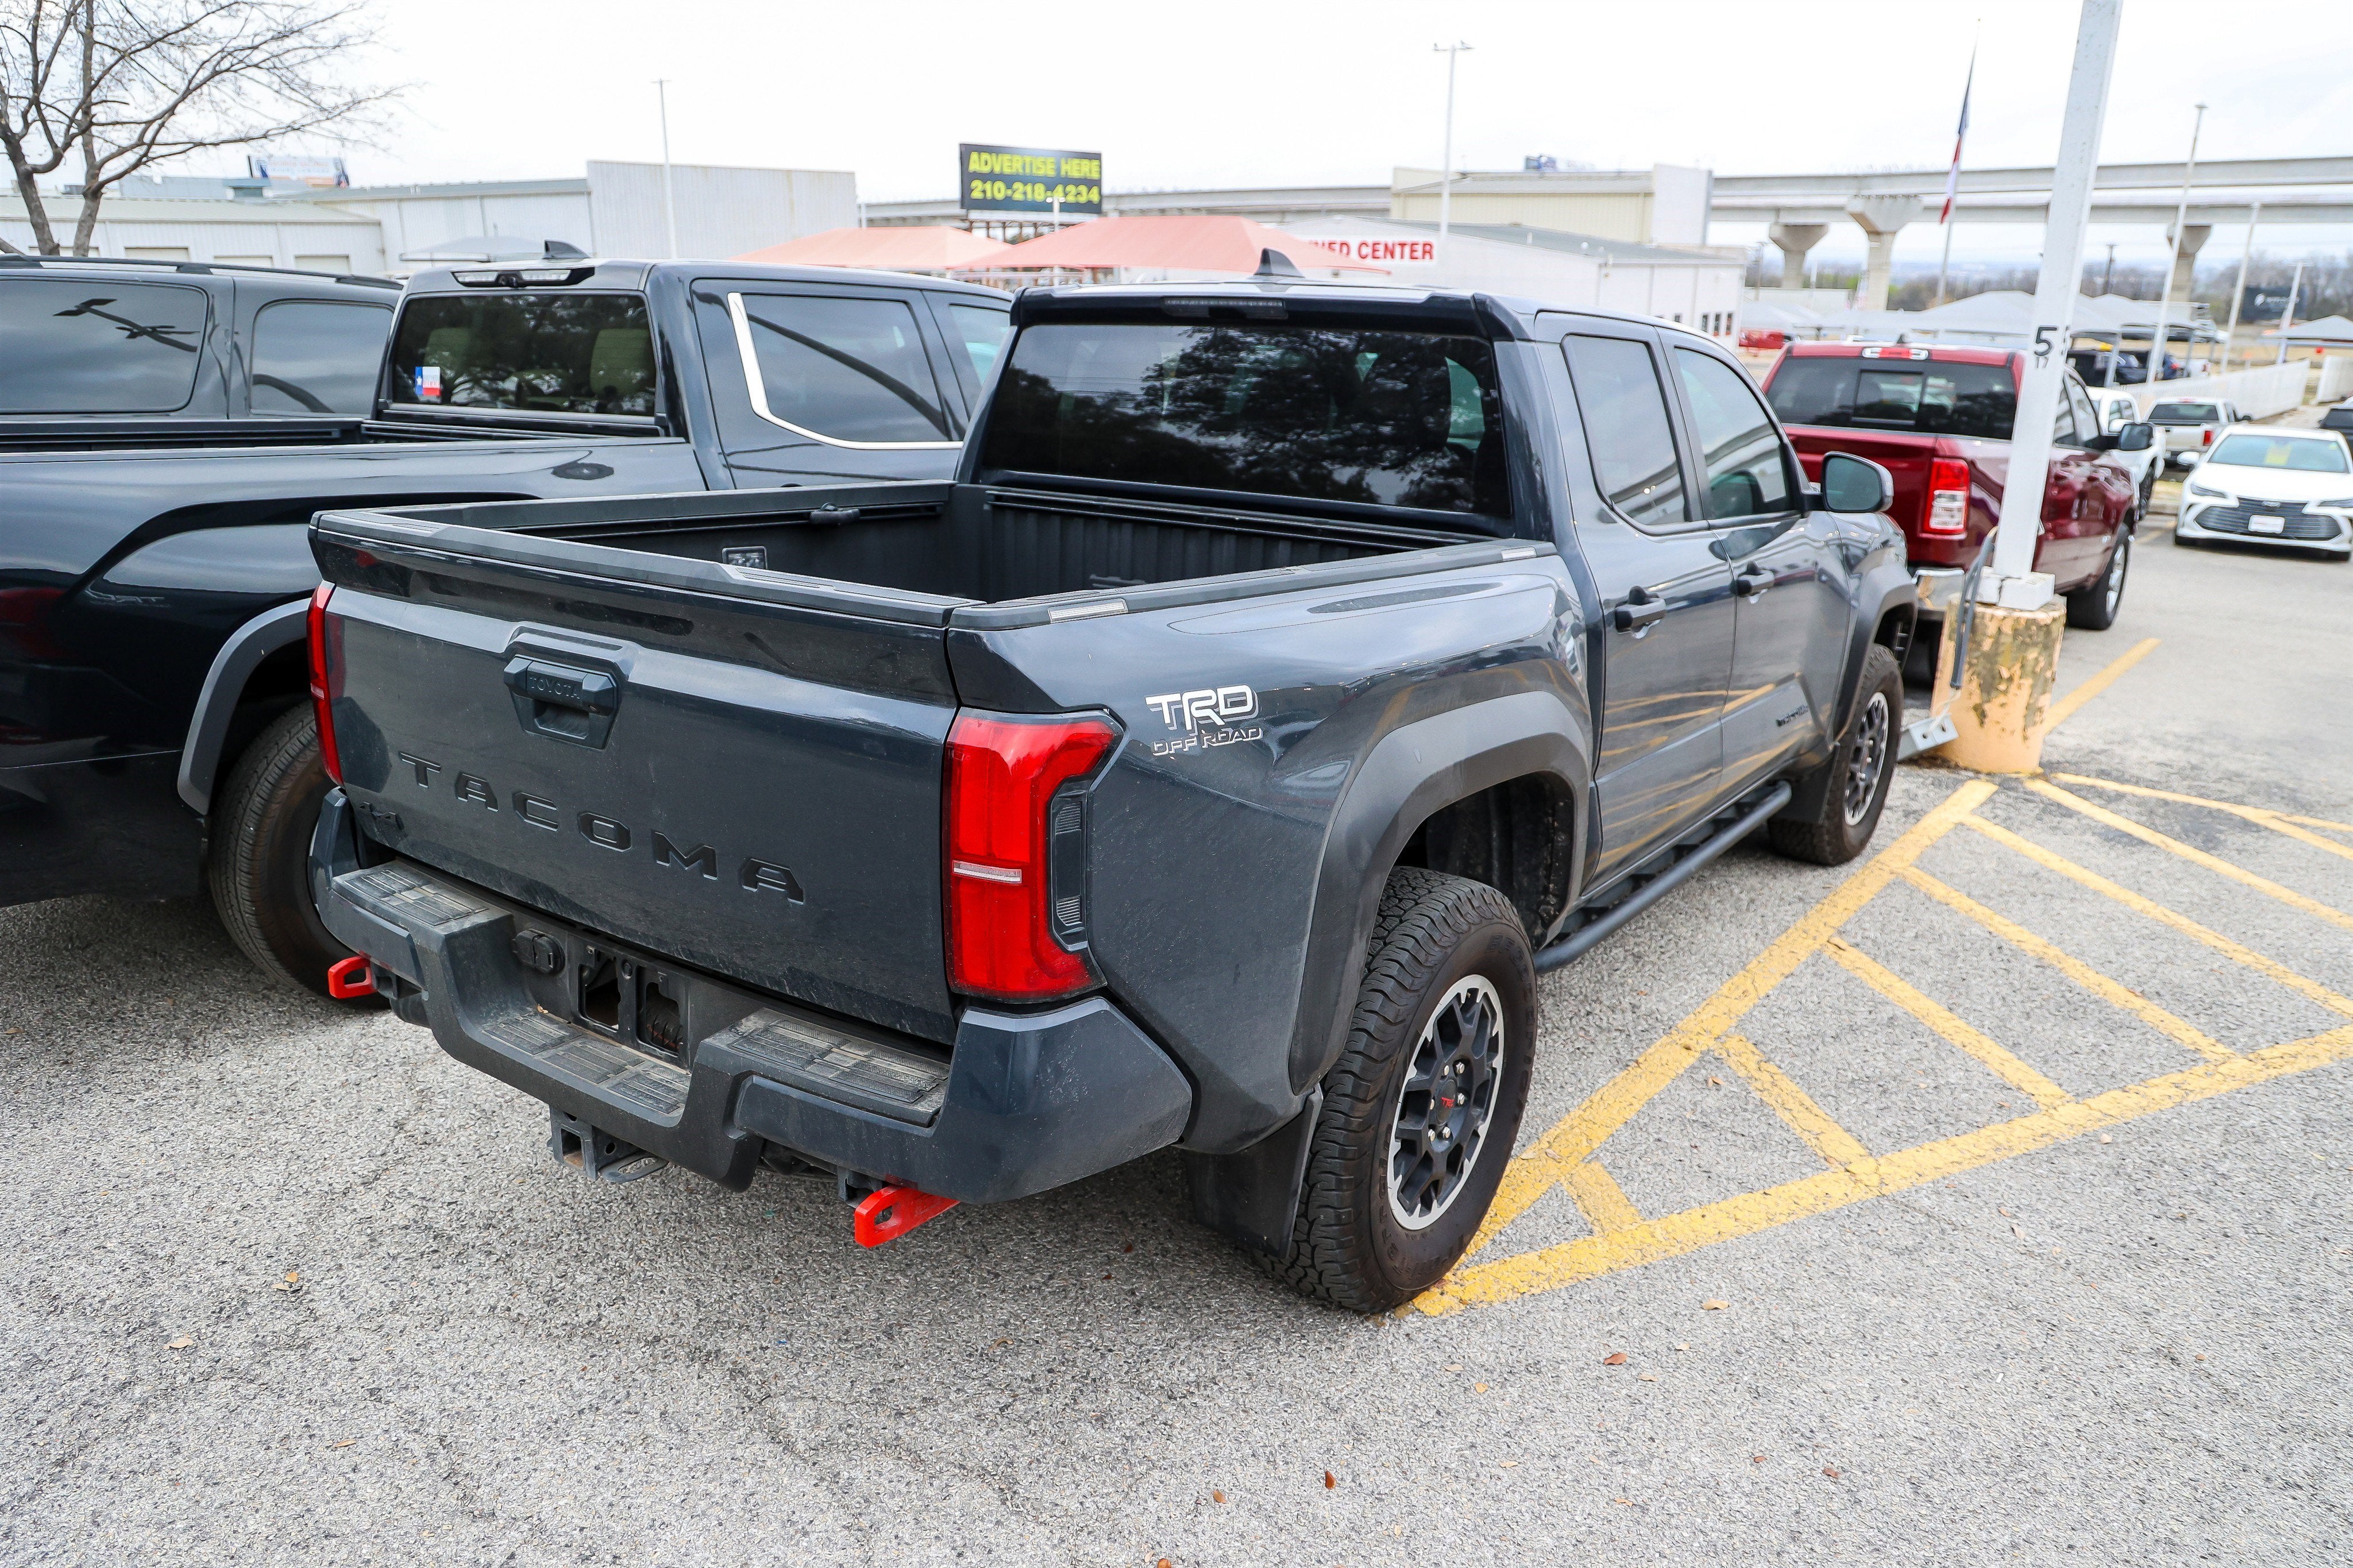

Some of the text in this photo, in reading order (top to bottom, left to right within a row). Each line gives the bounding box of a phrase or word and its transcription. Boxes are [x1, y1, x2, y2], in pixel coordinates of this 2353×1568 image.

[968, 151, 1100, 180] ADVERTISE HERE
[970, 180, 1100, 204] 210-218-4234
[1357, 241, 1434, 260] CENTER
[2034, 327, 2058, 356] 5
[1145, 684, 1259, 735] TRD
[1150, 726, 1263, 756] OFF ROAD
[399, 751, 805, 905] TACOMA
